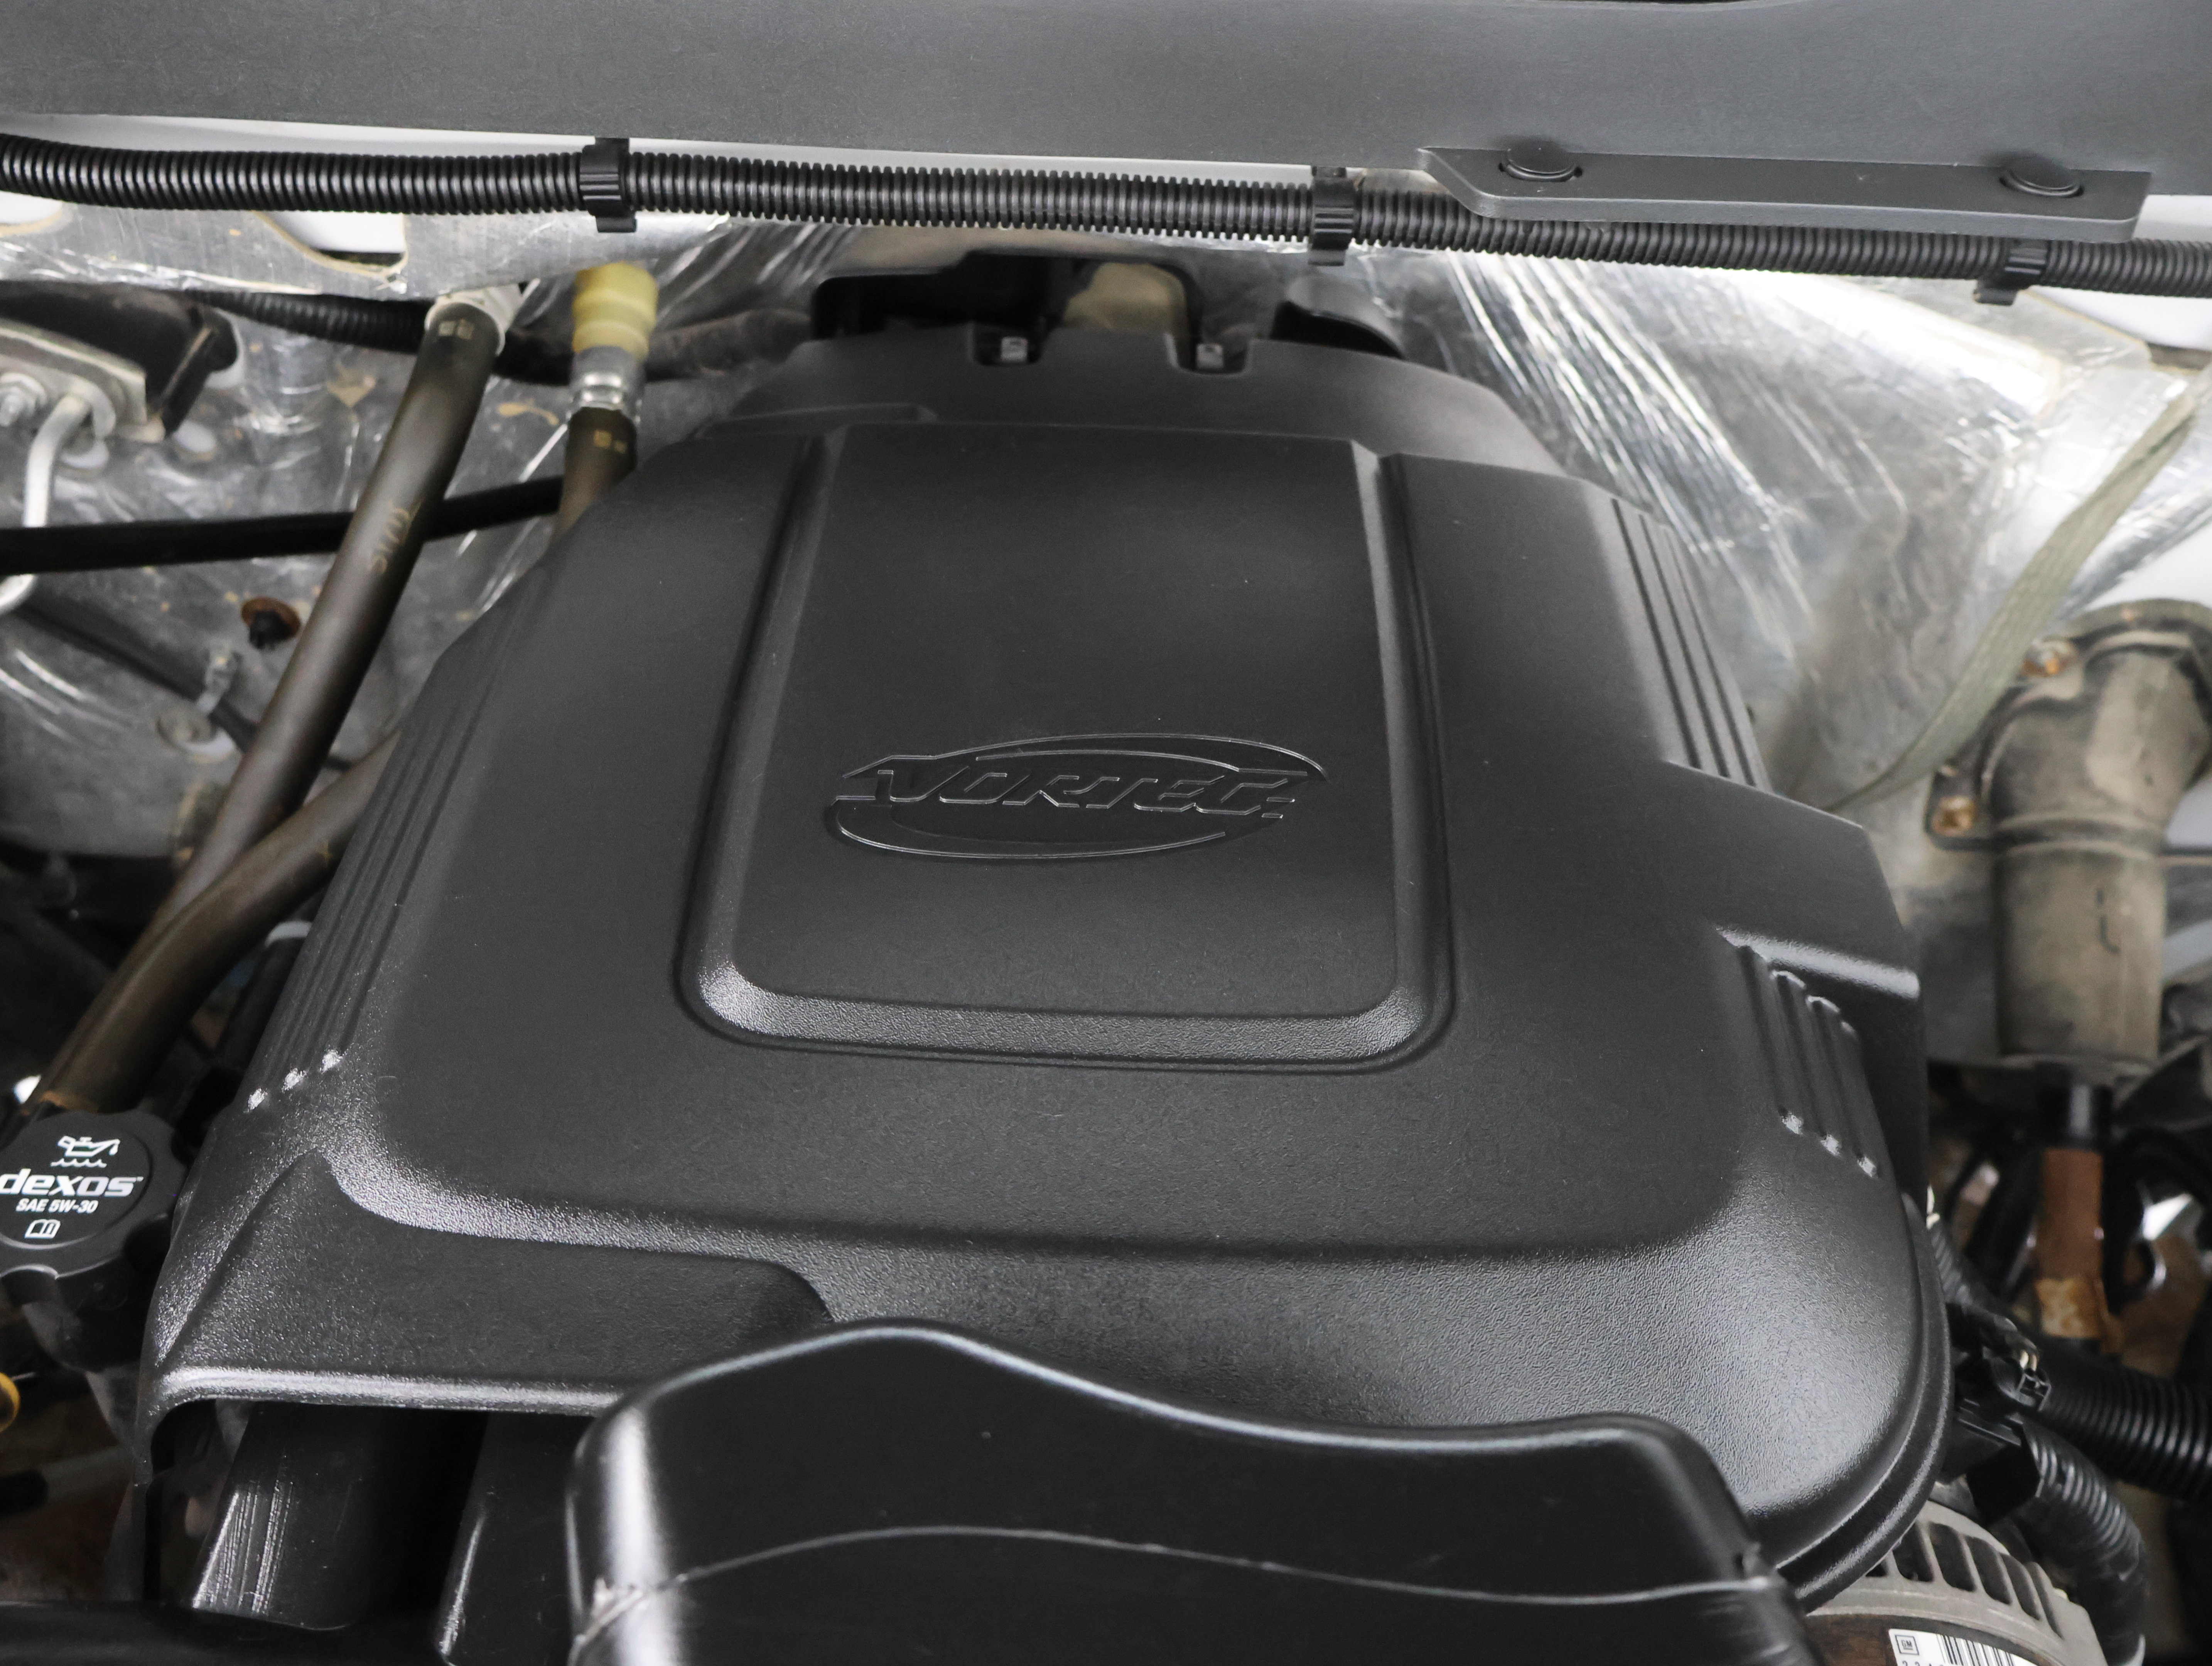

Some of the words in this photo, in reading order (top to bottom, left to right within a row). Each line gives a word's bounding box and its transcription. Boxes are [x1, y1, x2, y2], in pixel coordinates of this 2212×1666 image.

[876, 765, 1294, 818] VORTEC
[0, 1168, 143, 1196] dexos
[16, 1198, 49, 1212] SAE
[48, 1199, 99, 1213] 5W-30
[1901, 1639, 1913, 1648] GM
